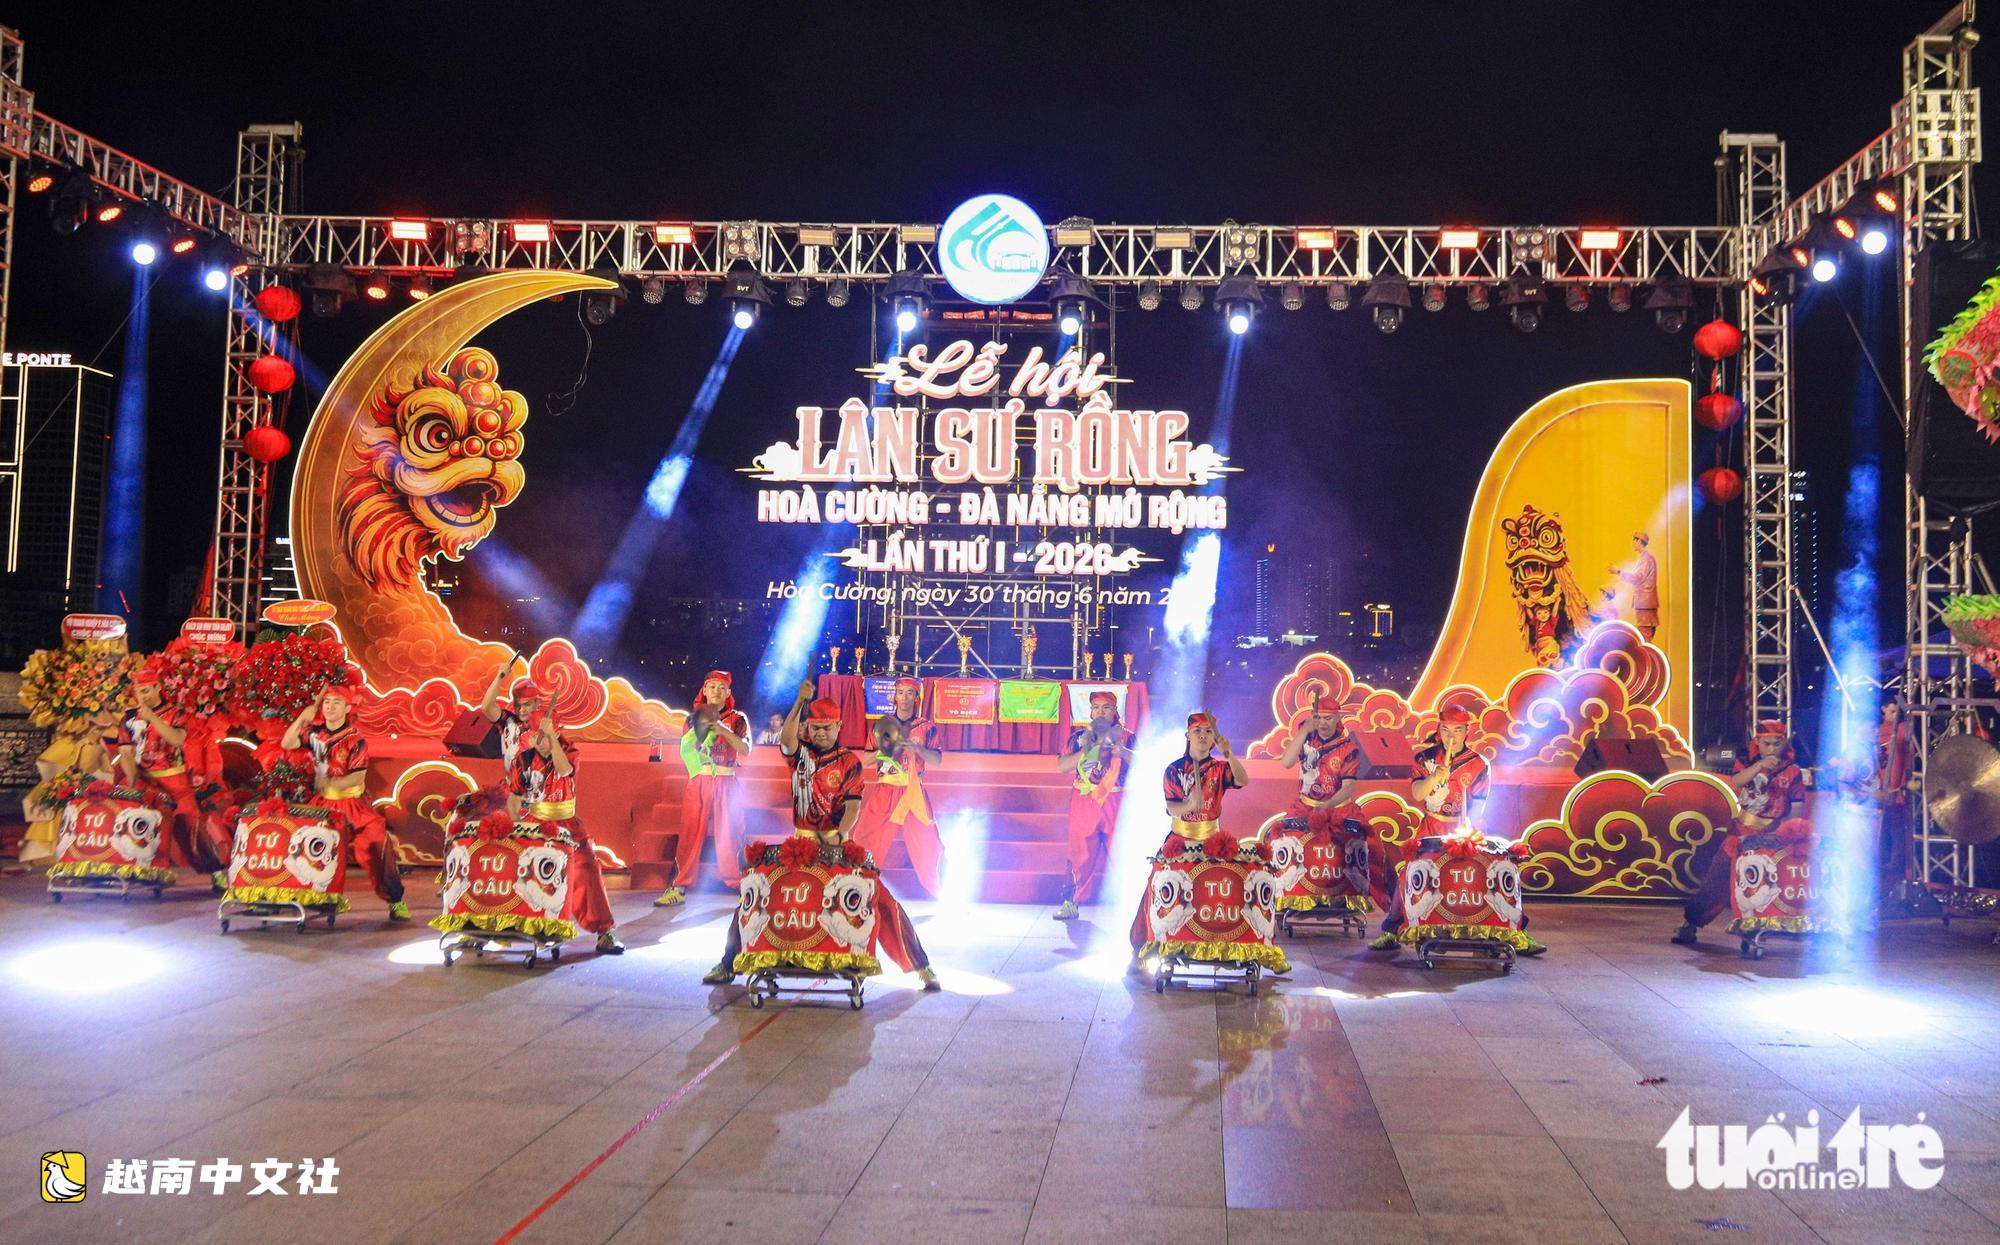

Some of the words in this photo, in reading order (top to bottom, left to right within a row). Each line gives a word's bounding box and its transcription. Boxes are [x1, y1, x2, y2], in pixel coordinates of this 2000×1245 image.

[16, 352, 72, 366] PONTE
[893, 339, 1009, 399] Lễ
[1008, 346, 1106, 407] hội
[795, 397, 919, 482] LÂN
[930, 397, 1025, 484] SƯ
[1033, 389, 1193, 494] RỒNG
[757, 484, 822, 523] HOÀ
[825, 484, 930, 525] CƯỜNG
[958, 486, 1001, 526] ĐÀ
[1006, 481, 1090, 528] NẴNG
[1094, 487, 1143, 528] MỞ
[1148, 489, 1227, 536] RỘNG
[928, 534, 990, 574] THỨ
[995, 540, 1006, 574] I
[1033, 542, 1114, 576] 2026
[901, 582, 960, 607] ngày
[964, 586, 995, 603] 30
[1002, 583, 1071, 609] tháng
[1078, 587, 1093, 604] 6
[1099, 585, 1151, 605] năm
[84, 812, 107, 828] TỨ
[76, 830, 109, 847] CÂU
[255, 831, 281, 849] TỨ
[1314, 843, 1336, 859] TỨ
[248, 852, 285, 870] CÂU
[479, 852, 507, 872] TỨ
[1309, 864, 1342, 880] CÂU
[1452, 867, 1476, 883] TỨ
[473, 877, 513, 896] CÂU
[780, 883, 811, 902] TỨ
[1204, 879, 1232, 897] TỨ
[1446, 890, 1482, 906] CÂU
[773, 909, 817, 930] CÂU
[1199, 902, 1241, 922] CÂU
